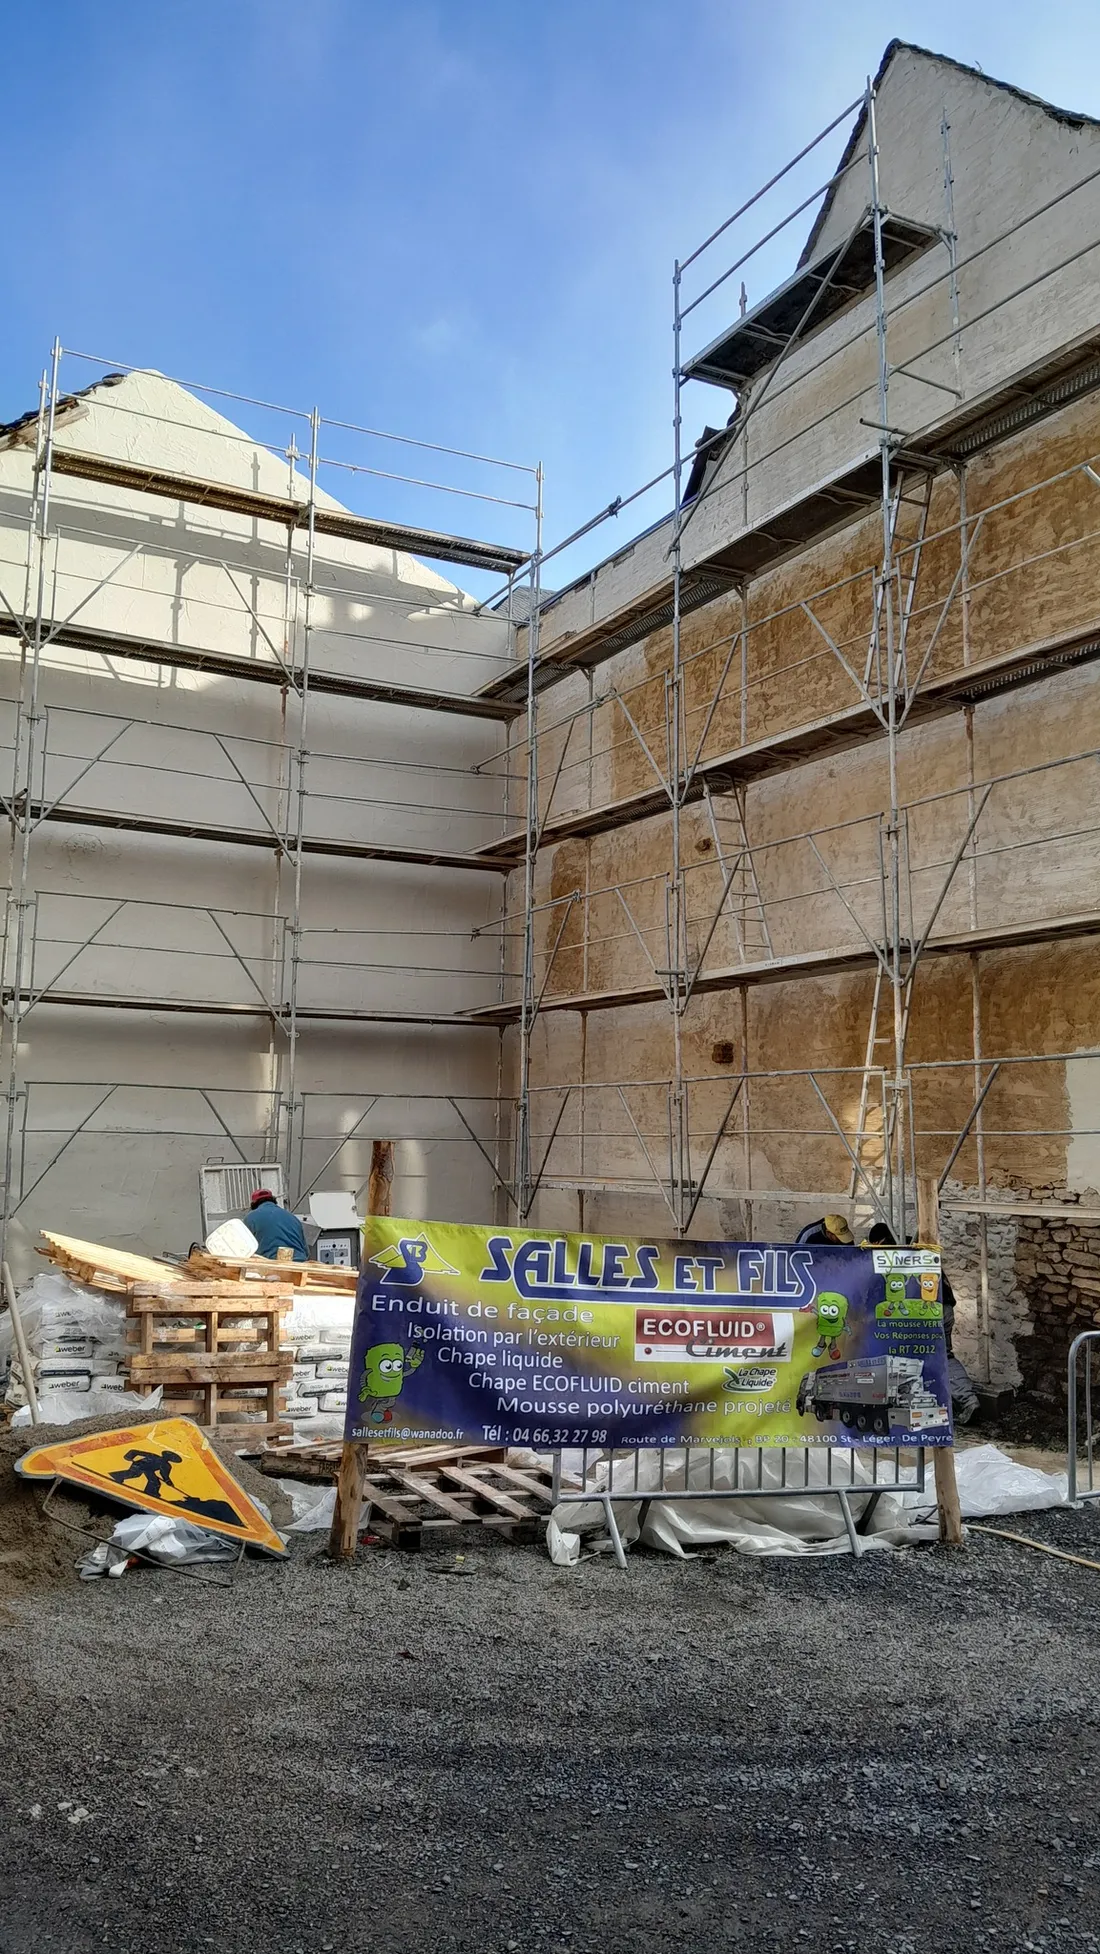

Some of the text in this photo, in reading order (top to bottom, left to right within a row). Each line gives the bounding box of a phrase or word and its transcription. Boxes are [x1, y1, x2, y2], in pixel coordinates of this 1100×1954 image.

[480, 1237, 816, 1299] SALLES ET FILS
[371, 1294, 595, 1324] Enduit de façade
[408, 1322, 621, 1348] Isolation par l'extérieur
[892, 1331, 930, 1340] Réponses
[61, 1345, 86, 1353] weber
[686, 1336, 788, 1359] Ciment
[899, 1345, 911, 1354] RT
[913, 1345, 936, 1354] 2012
[437, 1347, 564, 1371] Chape liquide
[738, 1367, 776, 1379] La Chape
[53, 1381, 80, 1389] weber
[468, 1372, 690, 1395] Chape ECOFLUID ciment
[497, 1397, 791, 1418] Mousse polyuréthane projeté
[351, 1427, 464, 1440] sallesetfils@wanadoo.fr
[621, 1435, 657, 1444] Route
[661, 1434, 676, 1444] de
[680, 1435, 741, 1445] Marvejols
[755, 1434, 770, 1443] BP
[774, 1434, 789, 1443] 20
[800, 1434, 838, 1443] 48100
[840, 1434, 851, 1443] St
[863, 1434, 896, 1444] Léger
[902, 1434, 917, 1443] De
[921, 1434, 953, 1444] Peyre
